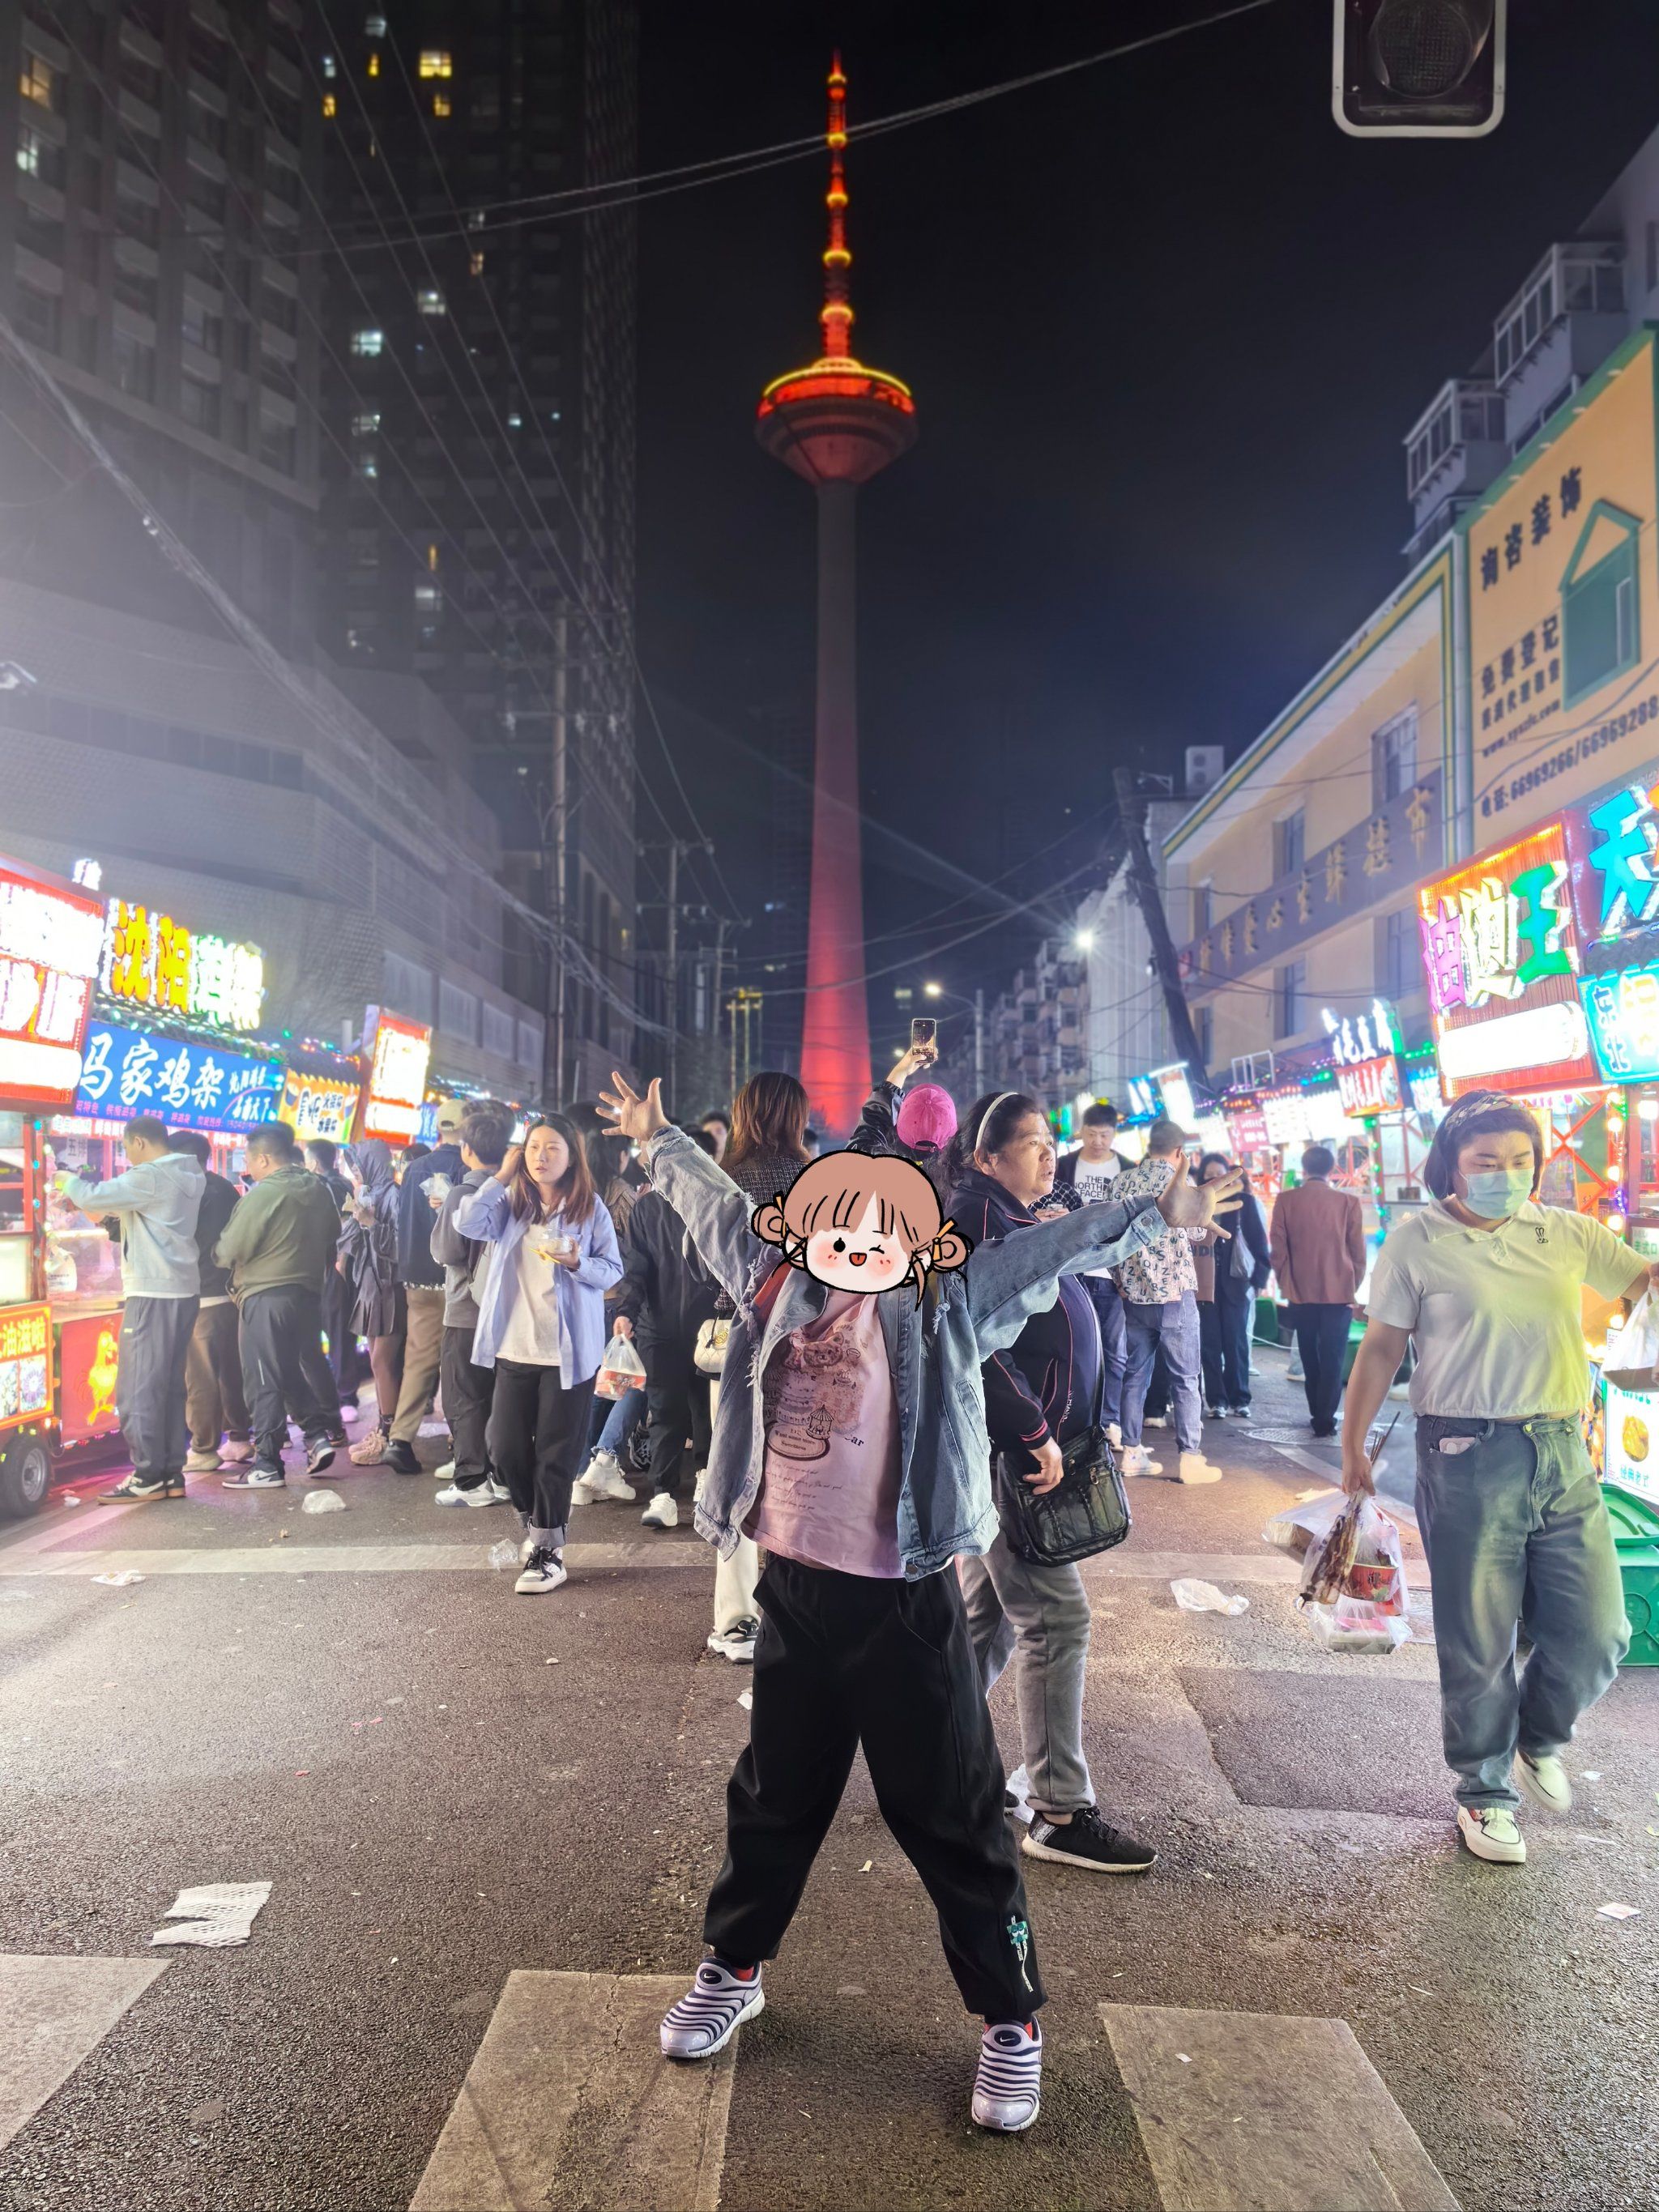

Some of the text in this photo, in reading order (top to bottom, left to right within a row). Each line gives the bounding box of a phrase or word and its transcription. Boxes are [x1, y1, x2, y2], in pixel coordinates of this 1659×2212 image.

[80, 1032, 225, 1110] 马家鸡架
[1085, 1175, 1102, 1183] THE
[1074, 1182, 1102, 1191] NORTH
[1080, 1190, 1102, 1198] FACE
[0, 1315, 46, 1359] 油滋啦
